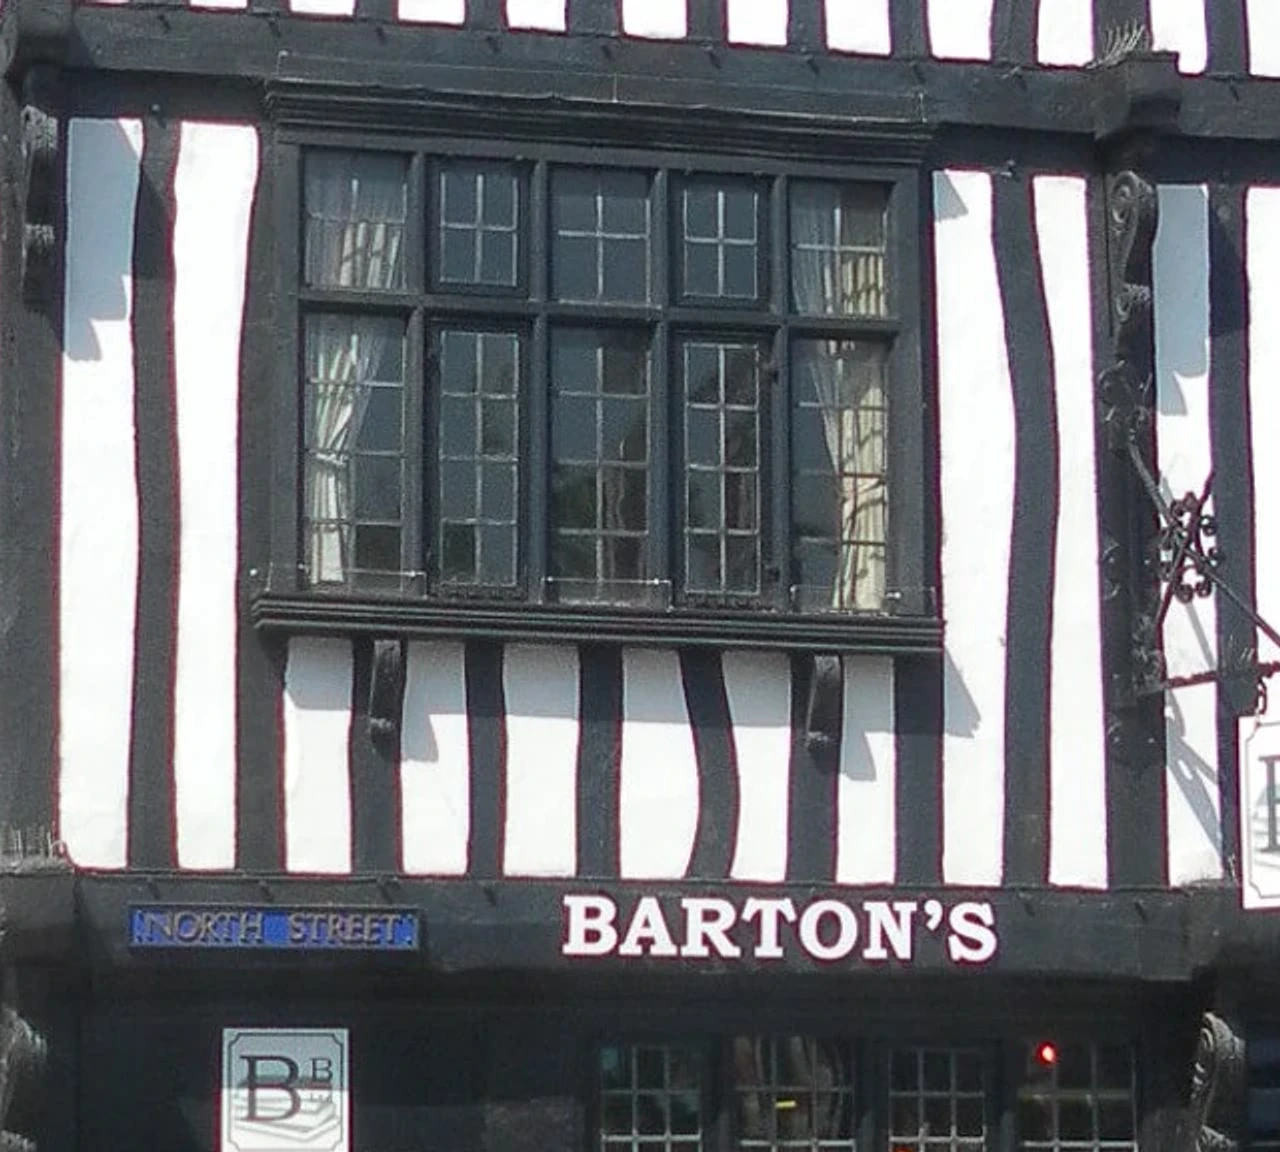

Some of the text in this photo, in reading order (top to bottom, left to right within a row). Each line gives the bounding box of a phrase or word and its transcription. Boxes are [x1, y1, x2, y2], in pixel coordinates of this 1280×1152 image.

[144, 910, 403, 947] NORTH STREET
[562, 894, 998, 962] BARTON'S
[239, 1055, 300, 1122] B
